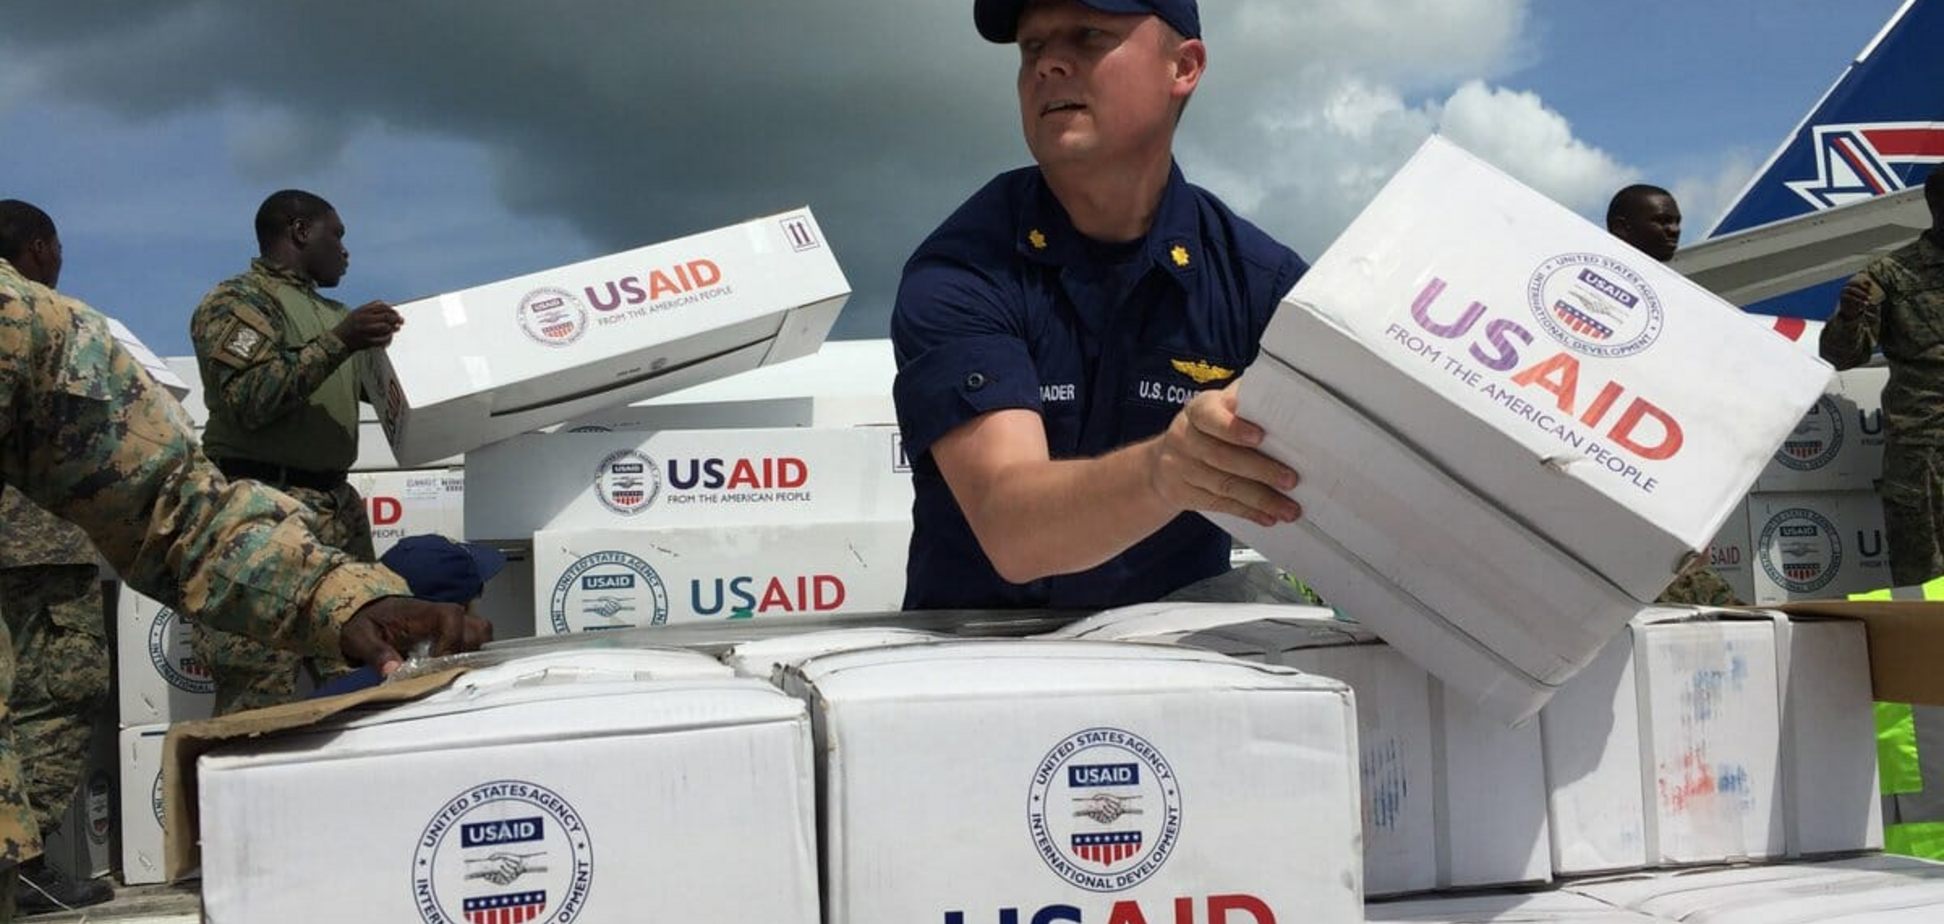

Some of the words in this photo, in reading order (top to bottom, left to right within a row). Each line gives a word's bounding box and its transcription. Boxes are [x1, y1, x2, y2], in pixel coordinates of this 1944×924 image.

[584, 258, 721, 312] USAID
[1585, 272, 1631, 303] USAID
[1602, 260, 1639, 283] STATES
[597, 313, 625, 327] FROM
[629, 307, 647, 320] THE
[650, 294, 699, 315] AMERICAN
[700, 285, 734, 301] PEOPLE
[1572, 333, 1652, 356] DEVELOPMENT
[1410, 276, 1684, 461] USAID
[1139, 381, 1164, 401] U.S.
[1167, 386, 1201, 404] COA
[1385, 322, 1442, 364] FROM
[1444, 355, 1482, 389] THE
[1481, 381, 1585, 448] AMERICAN
[1584, 440, 1659, 494] PEOPLE
[668, 458, 808, 490] USAID
[667, 495, 696, 504] FROM
[699, 494, 718, 503] THE
[720, 493, 774, 503] AMERICAN
[776, 492, 811, 501] PEOPLE
[558, 560, 589, 592] UNITED
[589, 553, 625, 564] STATES
[626, 559, 660, 588] AGENCY
[1710, 545, 1741, 565] SAID
[587, 576, 630, 588] USAID
[691, 574, 845, 616] USAID
[1036, 741, 1075, 785] UNITED
[1076, 731, 1125, 746] STATES
[1125, 737, 1171, 781] AGENCY
[1075, 767, 1131, 784] USAID
[423, 798, 469, 848] UNITED
[471, 784, 528, 800] STATES
[528, 788, 582, 833] AGENCY
[469, 822, 536, 843] USAID
[1031, 813, 1113, 889] INTERNATIONAL
[1116, 806, 1179, 887] DEVELOPMENT
[552, 859, 589, 924] OPMENT
